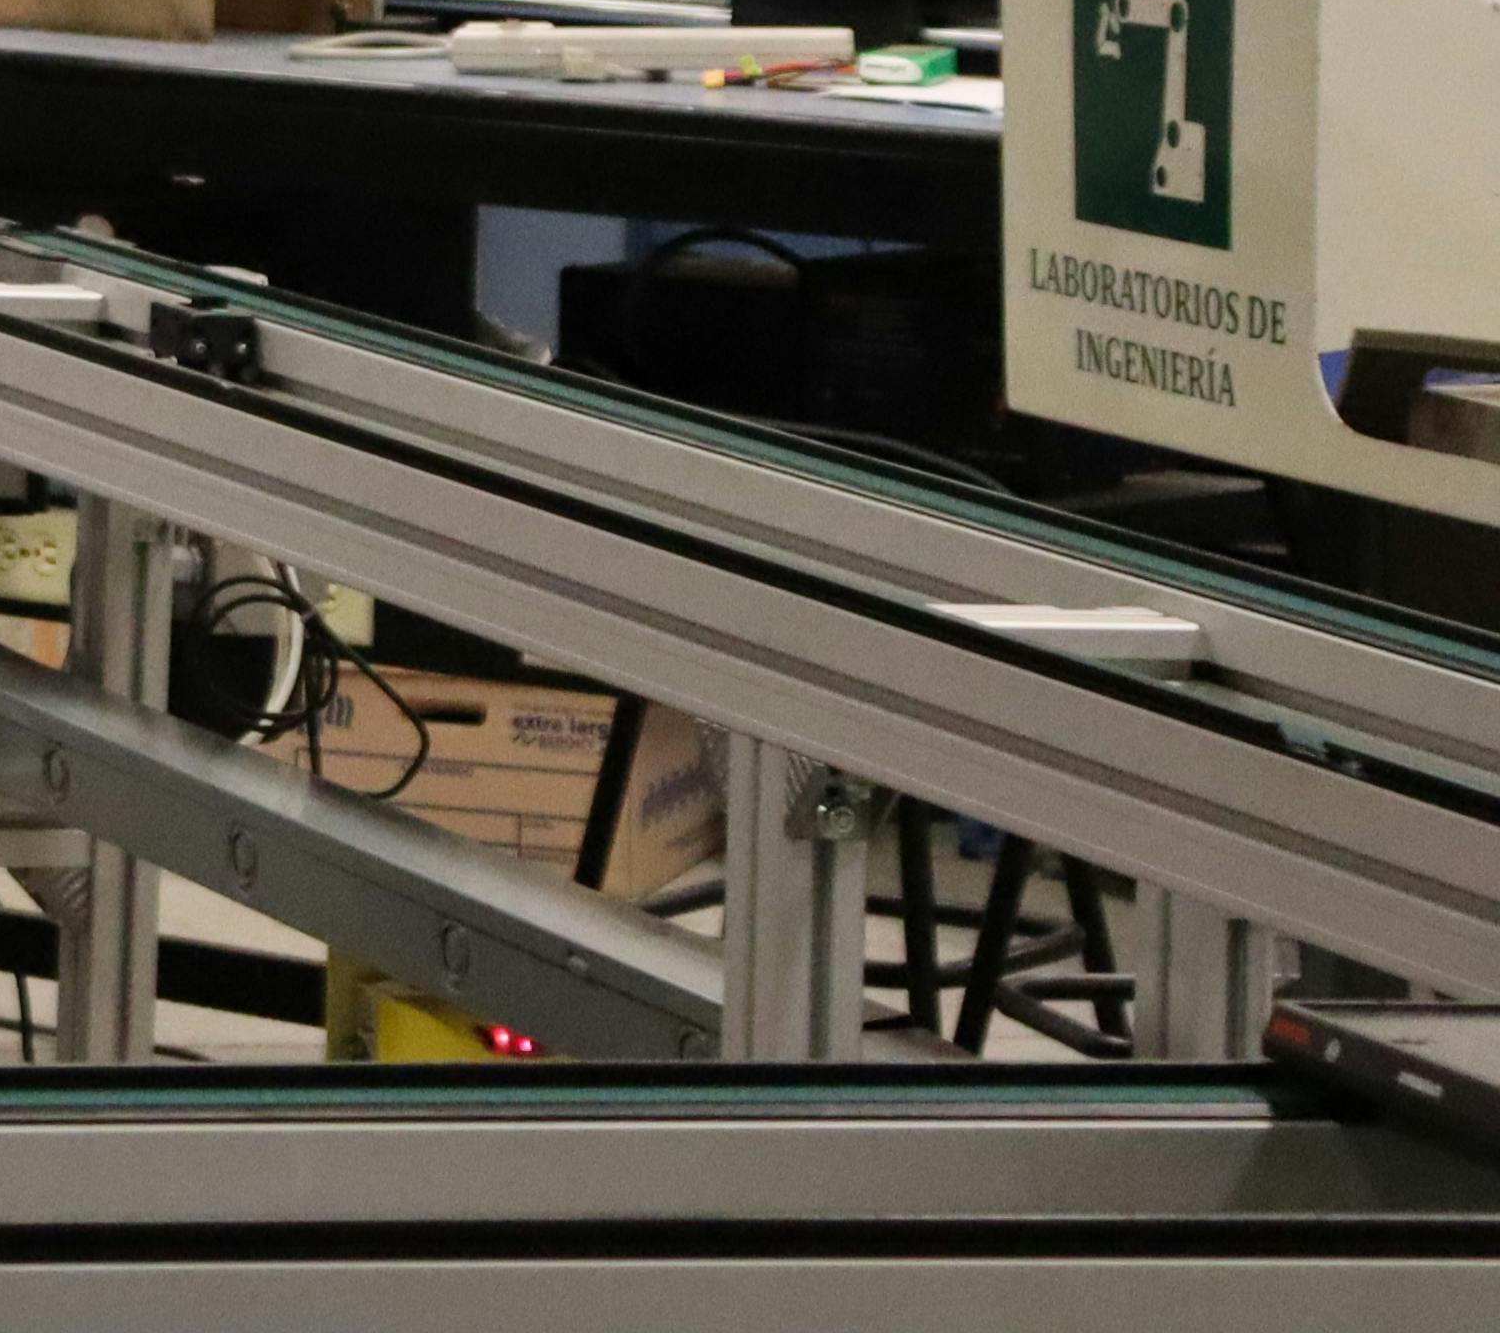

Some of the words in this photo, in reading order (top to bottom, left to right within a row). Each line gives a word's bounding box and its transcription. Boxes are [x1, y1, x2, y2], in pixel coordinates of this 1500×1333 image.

[1028, 247, 1240, 335] LABORATORIOS
[1247, 293, 1287, 345] DE
[1075, 327, 1237, 408] INGENIERÍA
